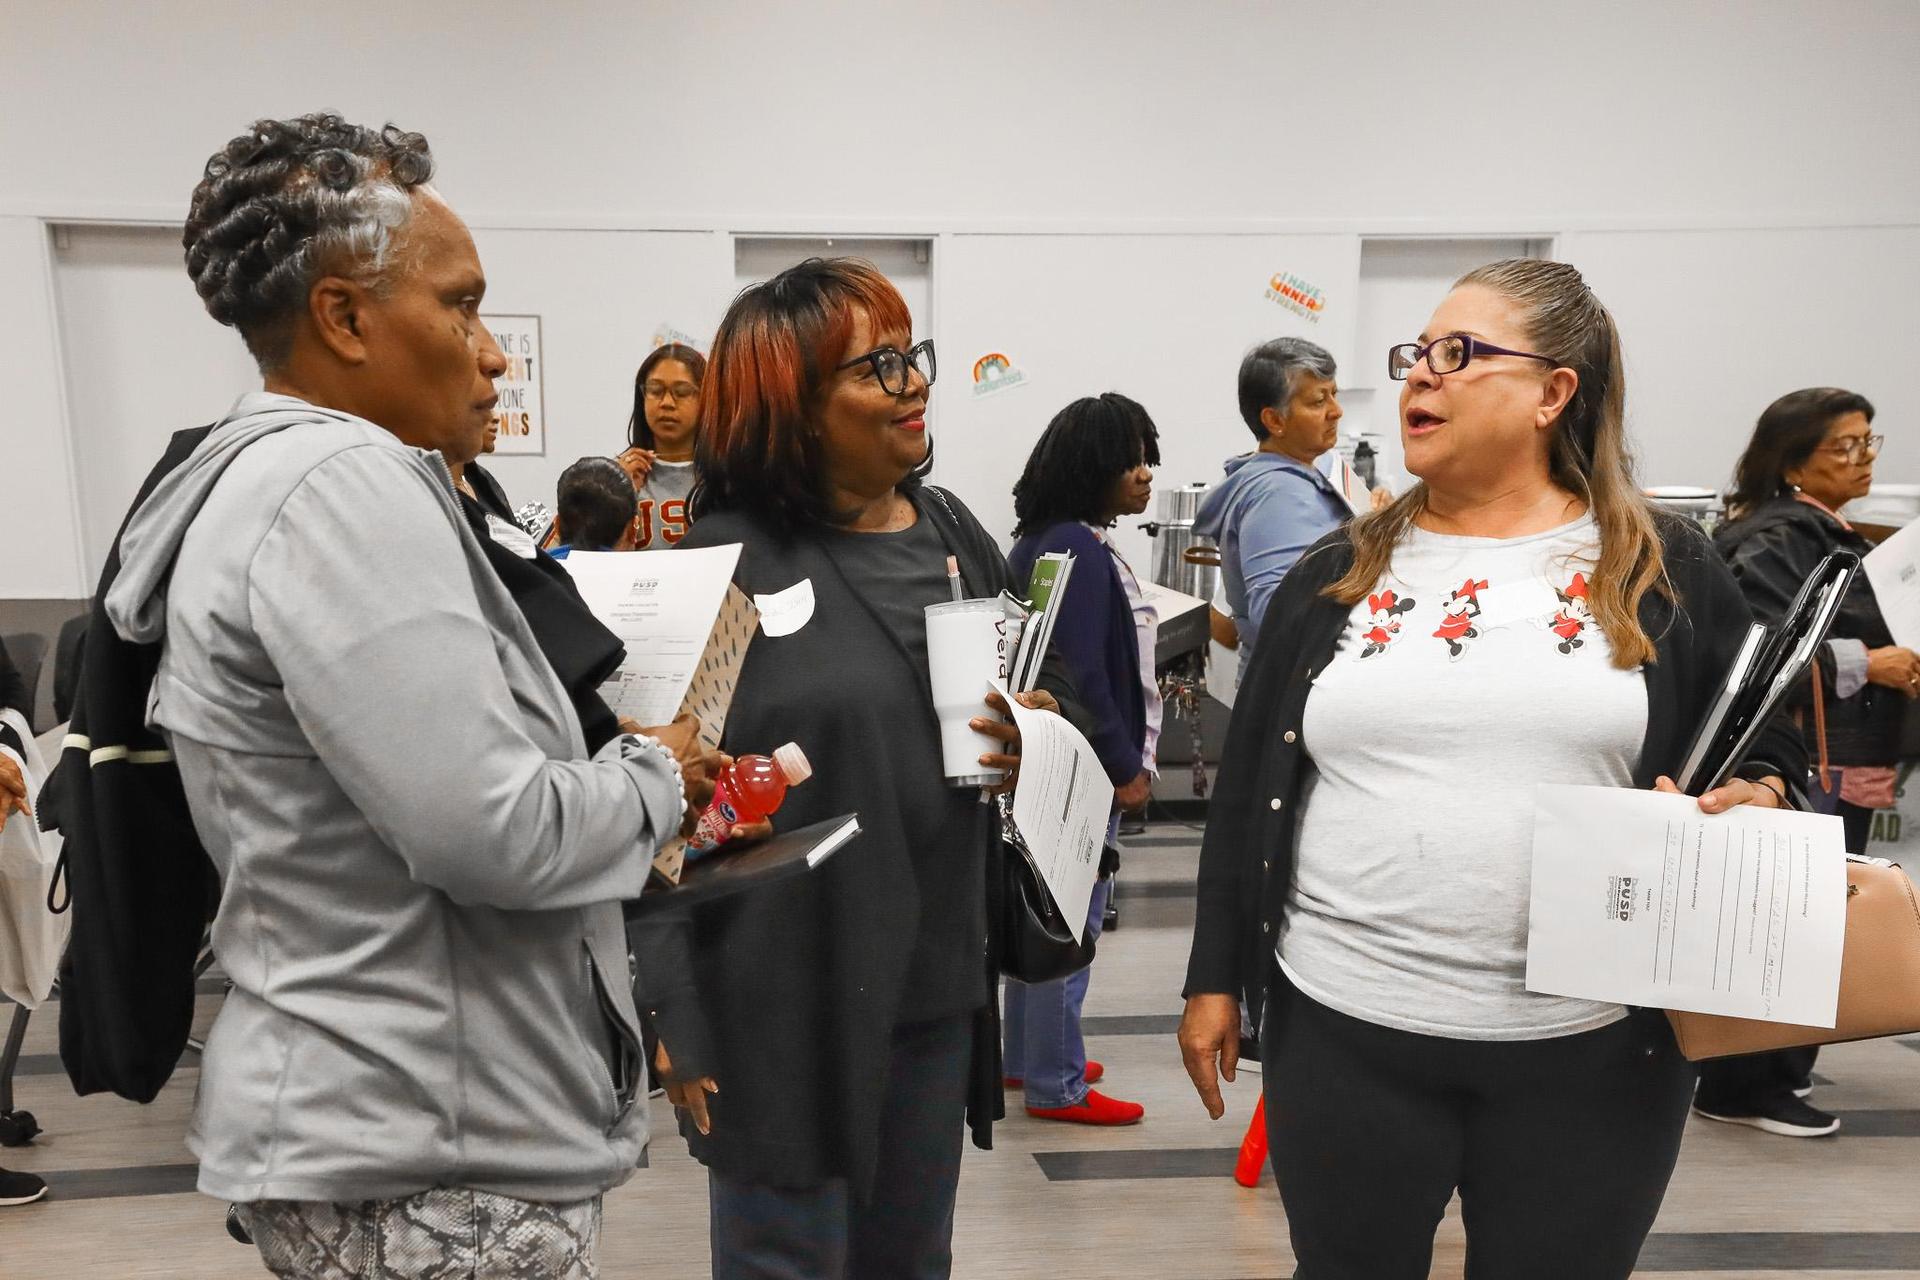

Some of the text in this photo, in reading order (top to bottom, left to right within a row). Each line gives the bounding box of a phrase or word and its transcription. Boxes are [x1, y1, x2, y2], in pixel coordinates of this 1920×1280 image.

[1275, 282, 1317, 310] INNER
[1287, 275, 1320, 299] HAVE
[1264, 289, 1321, 324] STRENGTH
[519, 334, 531, 354] IS
[1619, 877, 1632, 922] PUSD
